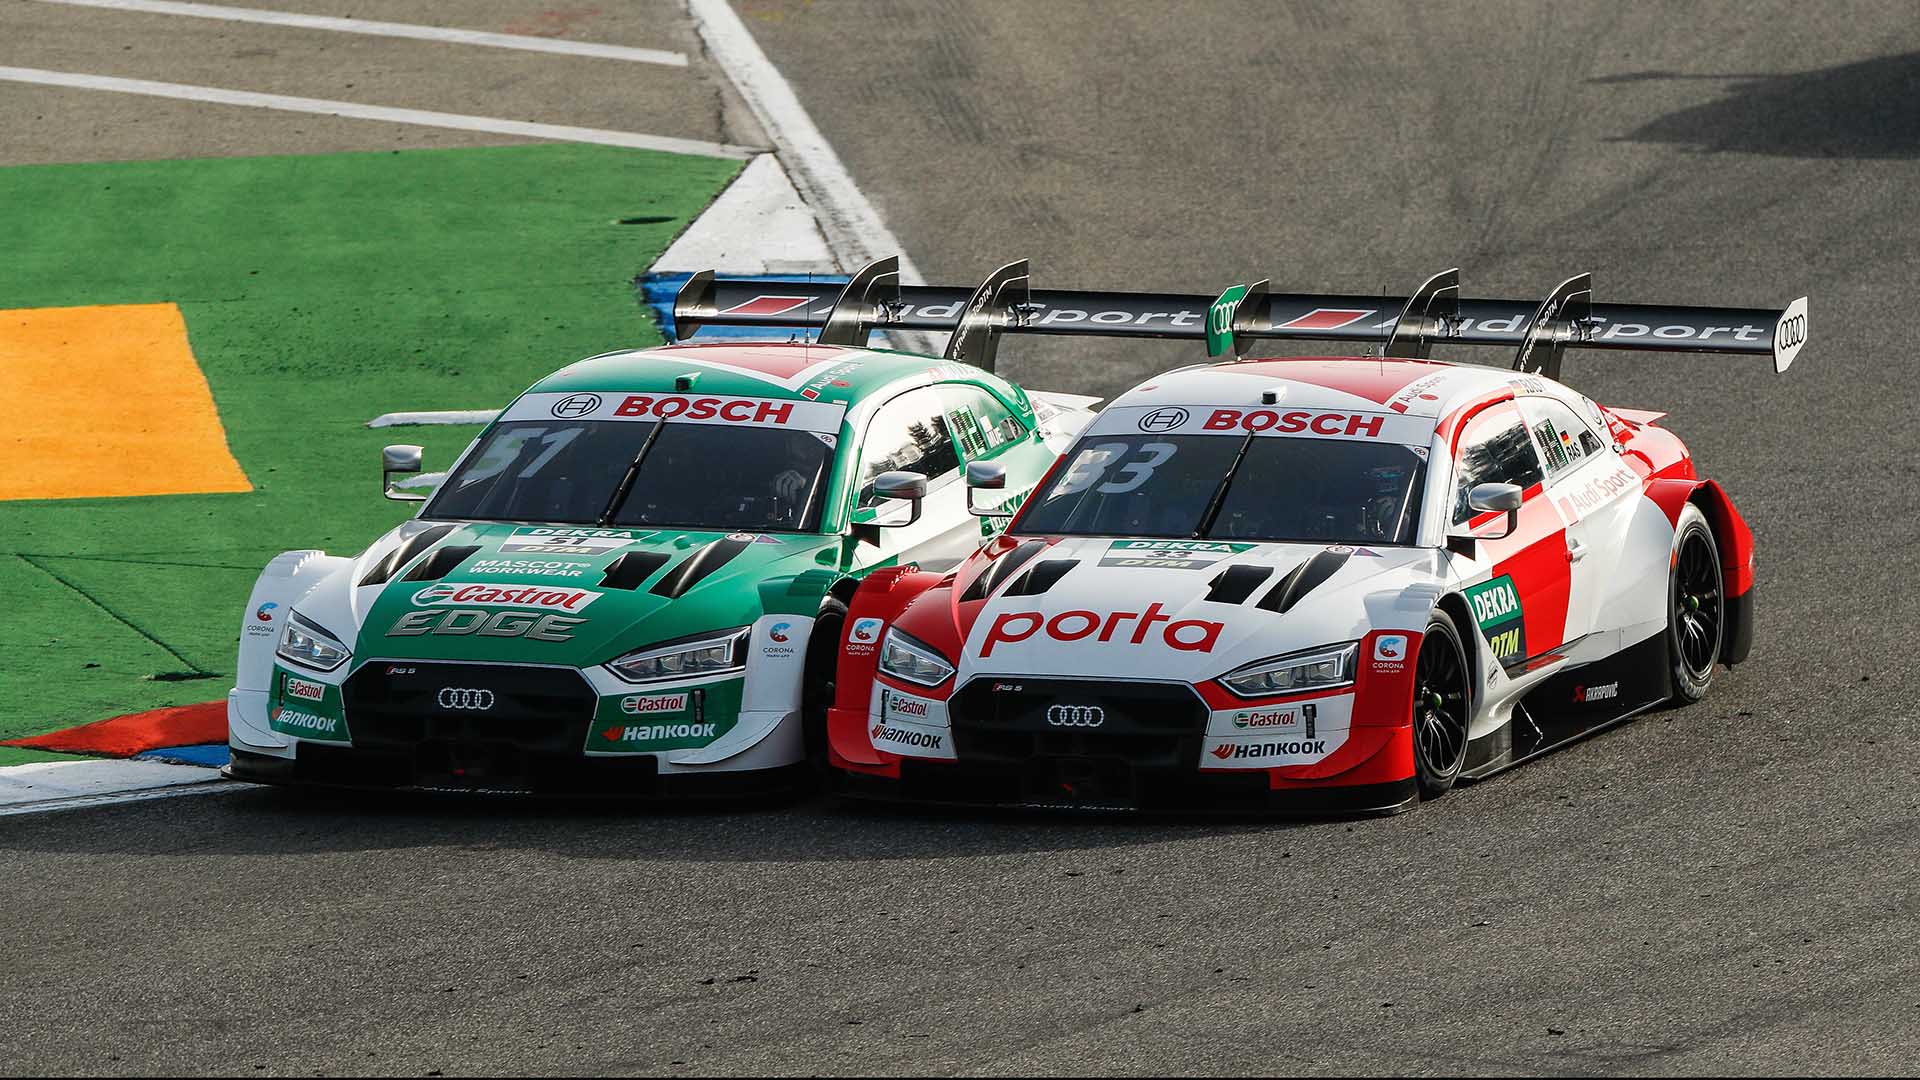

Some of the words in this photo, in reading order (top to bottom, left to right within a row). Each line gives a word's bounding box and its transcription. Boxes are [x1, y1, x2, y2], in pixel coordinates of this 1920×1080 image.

[613, 395, 794, 425] BOSCH
[1201, 410, 1385, 437] BOSCH
[463, 427, 584, 481] 51
[1052, 442, 1178, 495] 33
[1596, 468, 1636, 500] Sport
[528, 528, 633, 539] DEKRA
[1127, 541, 1233, 553] DEKRA
[1146, 550, 1193, 558] 33
[469, 567, 583, 578] WORKWEAR
[1117, 560, 1193, 568] DTM
[453, 586, 587, 609] Castrol
[1473, 583, 1518, 623] DEKRA
[247, 624, 274, 632] CORONA
[384, 609, 591, 642] EDGE
[979, 603, 1224, 658] porta
[1490, 627, 1519, 659] DTM
[295, 679, 322, 699] Castrol
[637, 695, 684, 712] Castrol
[897, 698, 928, 716] Castrol
[1249, 711, 1295, 727] Castrol
